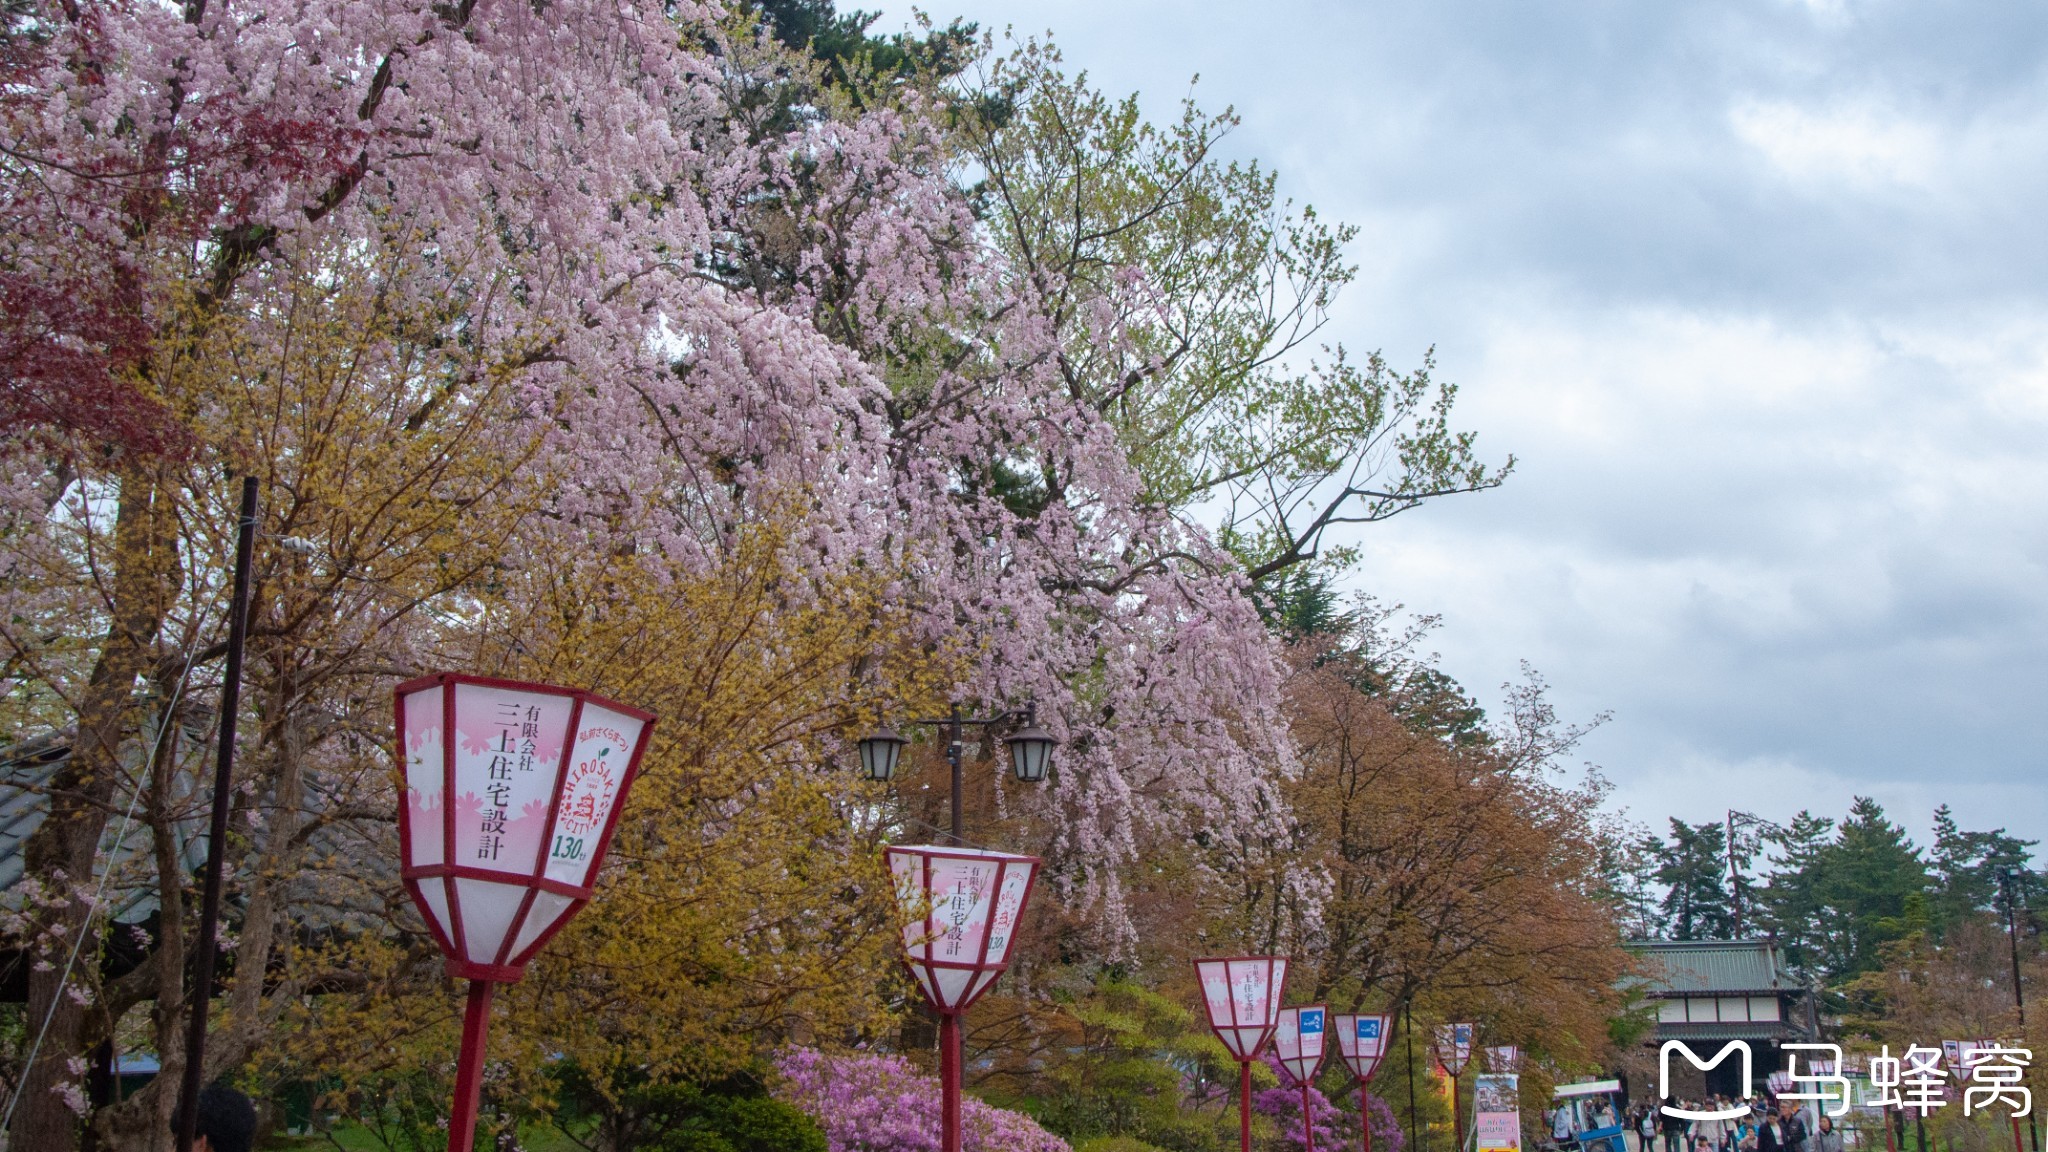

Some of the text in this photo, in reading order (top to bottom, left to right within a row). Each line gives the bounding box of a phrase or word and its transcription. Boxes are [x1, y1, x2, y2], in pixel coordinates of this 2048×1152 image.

[517, 704, 541, 772] 有限会社
[579, 726, 629, 752] 弘前さくらまつり
[478, 702, 521, 861] 三上住宅設計
[565, 758, 614, 799] HIROSAKI
[565, 818, 590, 835] CITY
[946, 865, 968, 956] 三上住宅設計
